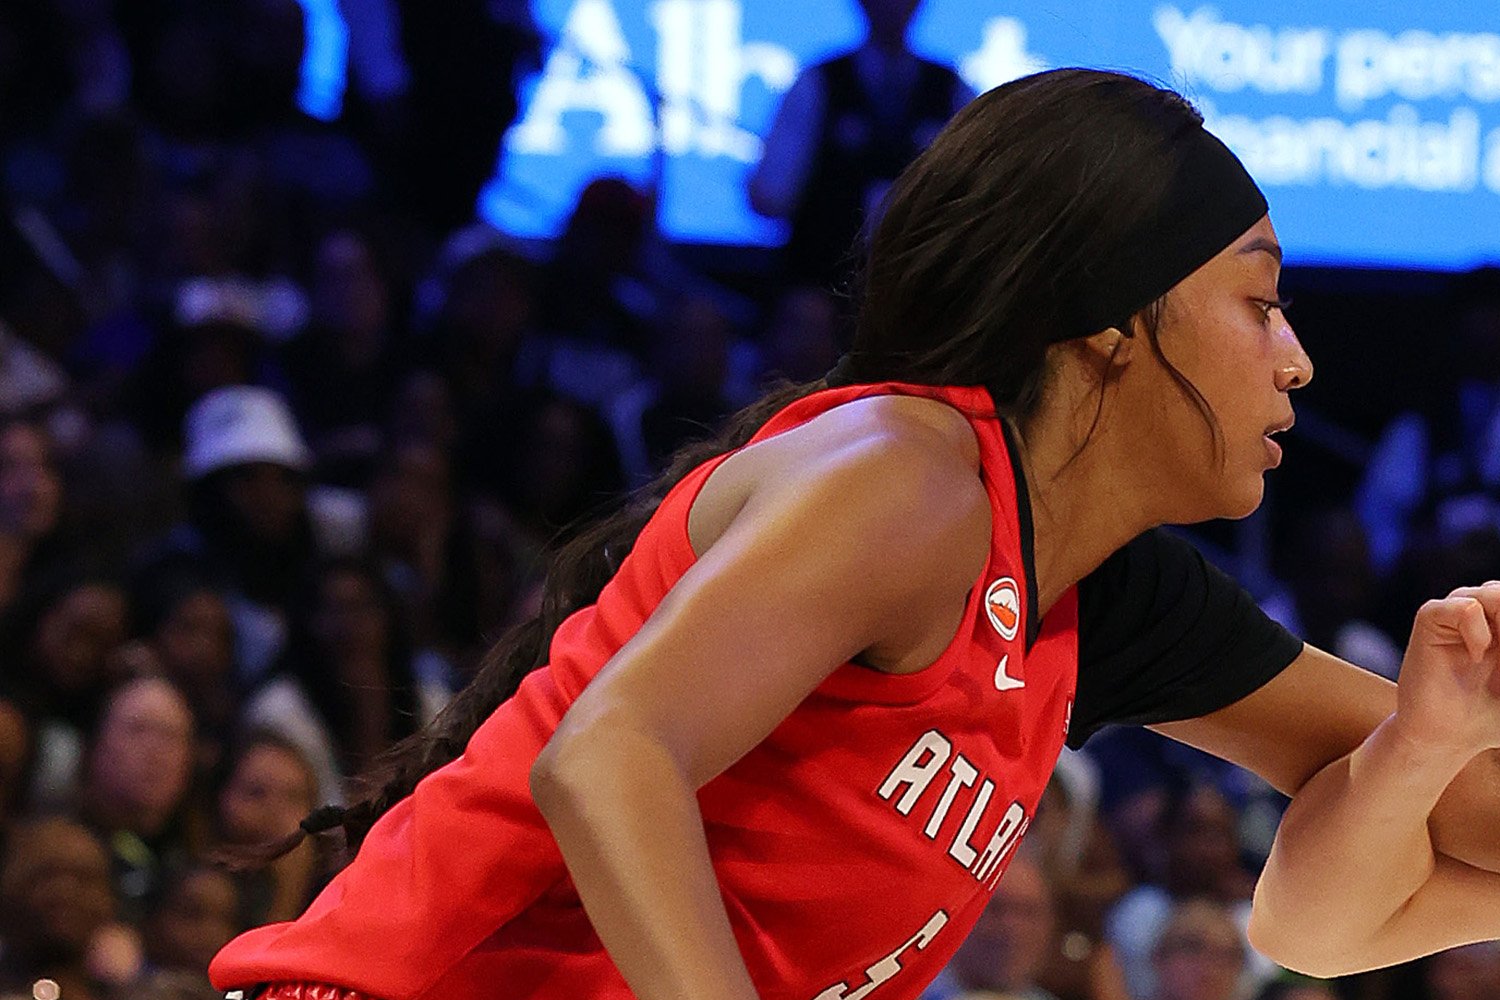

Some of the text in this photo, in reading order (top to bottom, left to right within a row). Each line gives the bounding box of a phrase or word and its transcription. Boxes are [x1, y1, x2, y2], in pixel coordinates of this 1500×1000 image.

[1154, 5, 1325, 93] Your
[1197, 98, 1480, 194] nancial
[877, 728, 1031, 892] ATLA
